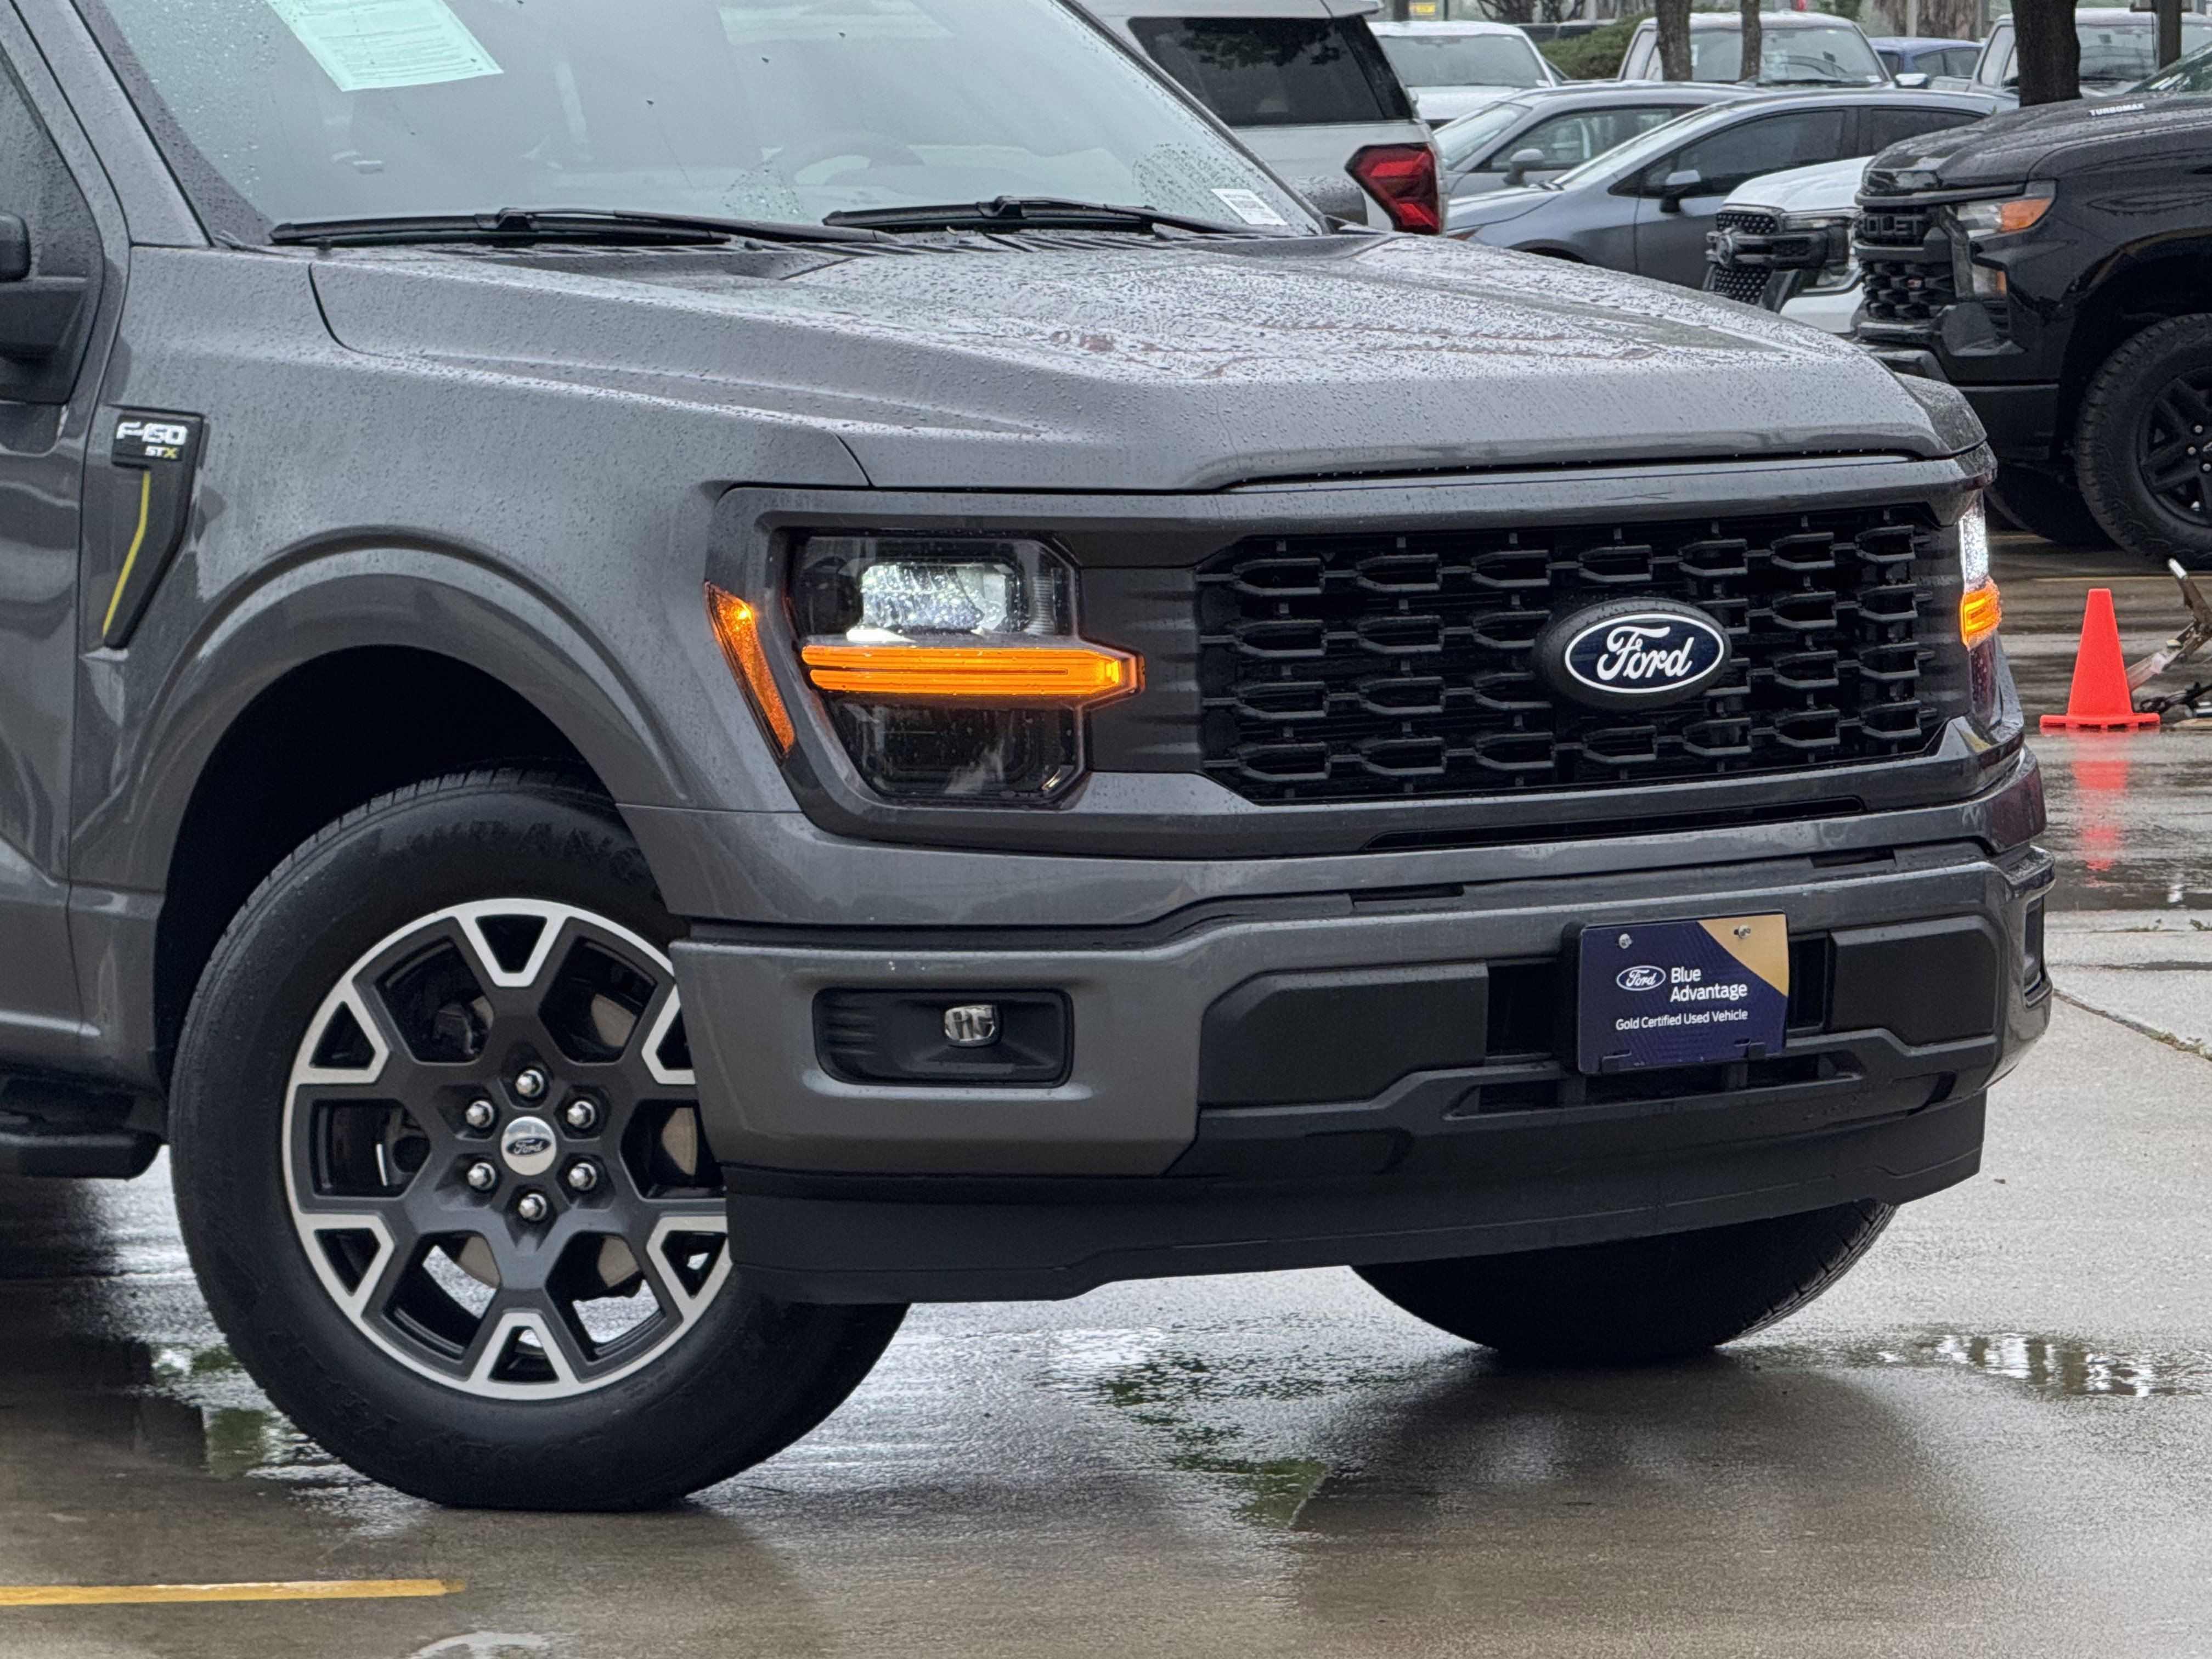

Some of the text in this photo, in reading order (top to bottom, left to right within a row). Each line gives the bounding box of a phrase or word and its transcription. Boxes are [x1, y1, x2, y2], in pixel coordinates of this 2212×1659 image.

[145, 445, 178, 459] STX
[1597, 626, 1695, 681] Ford
[1626, 969, 1656, 987] Ford
[1671, 966, 1701, 984] Blue
[1670, 984, 1748, 1002] Advantage
[1616, 1008, 1748, 1030] Gold Certified Used Vehicle
[514, 1139, 544, 1154] Ford
